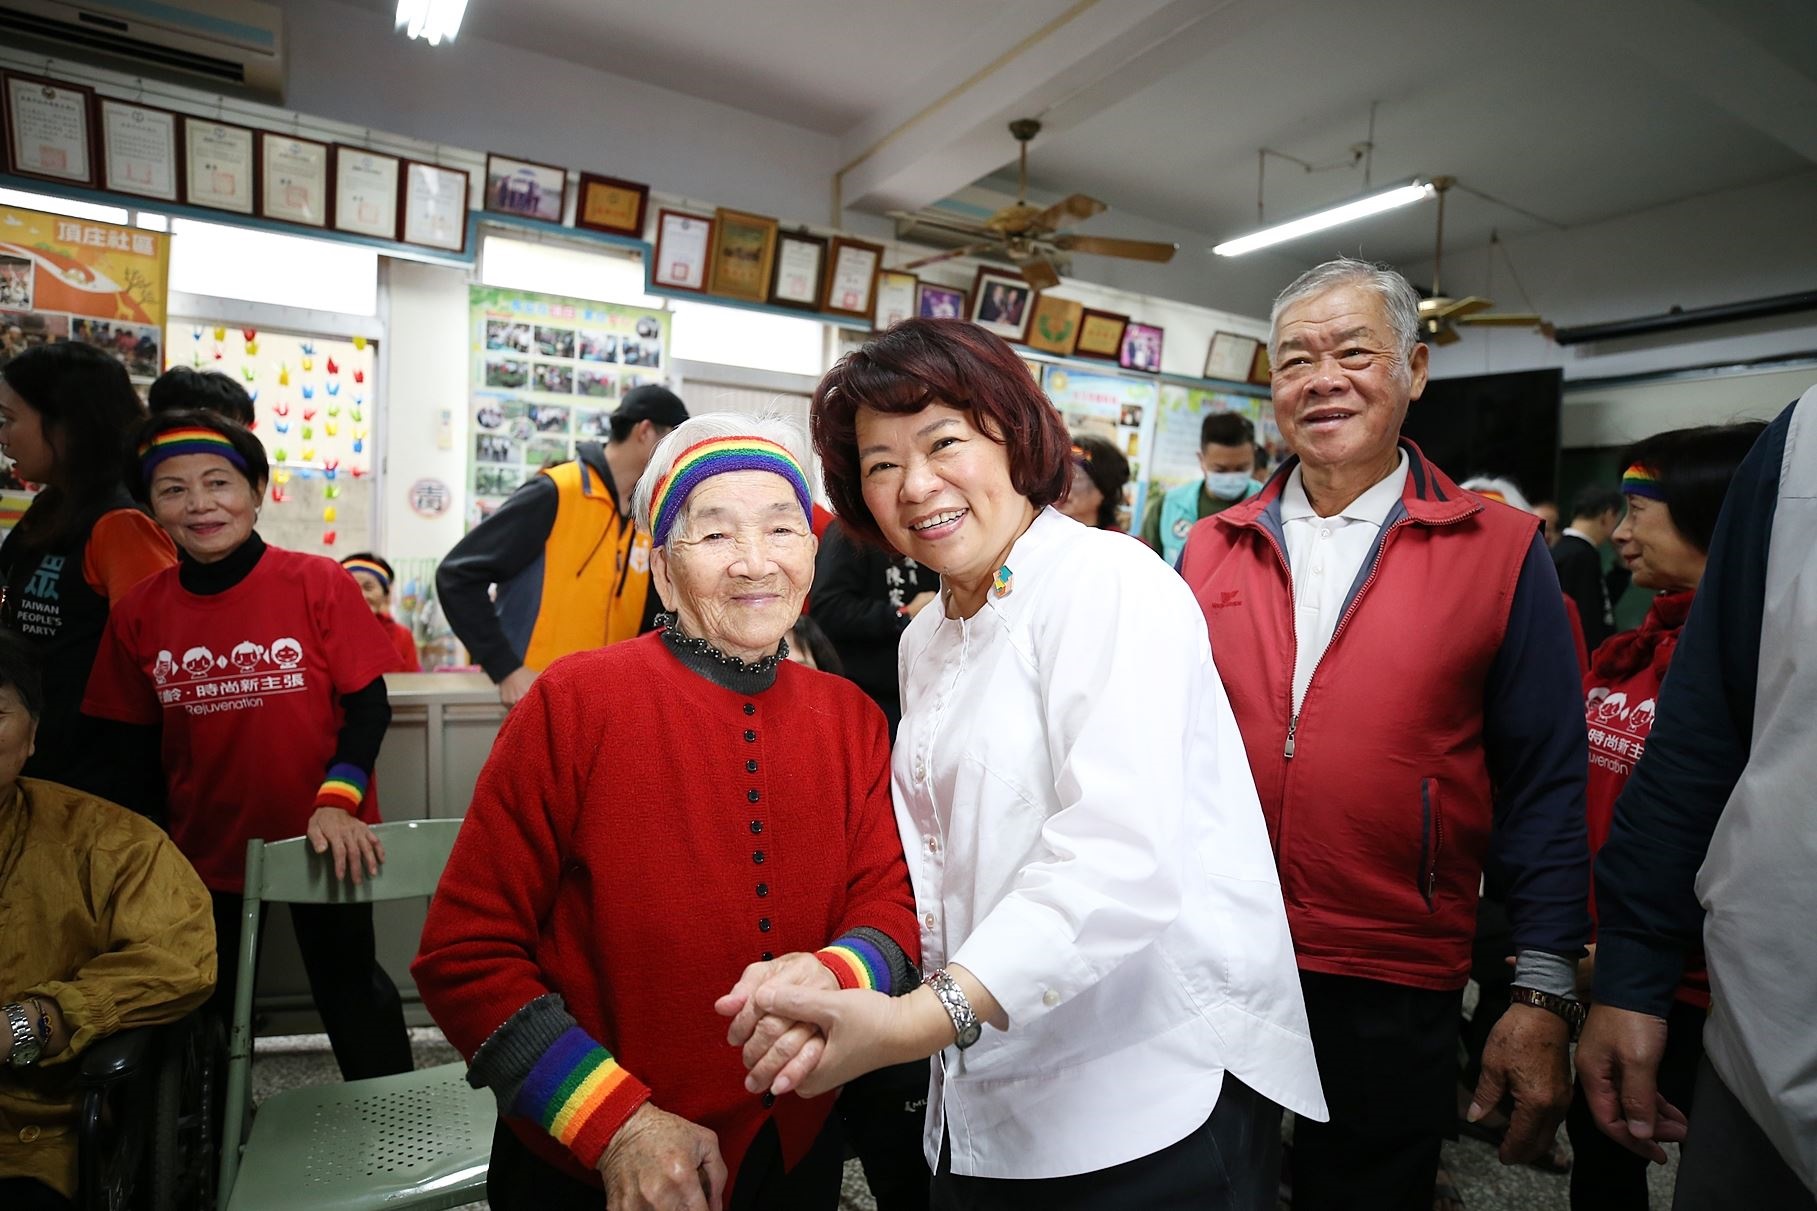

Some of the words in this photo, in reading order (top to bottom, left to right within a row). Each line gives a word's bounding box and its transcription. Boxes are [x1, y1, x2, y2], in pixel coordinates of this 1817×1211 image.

[58, 222, 155, 256] 頂庄社區
[22, 599, 60, 615] TAIWAN
[17, 610, 63, 626] PEOPLE'S
[22, 623, 57, 636] PARTY
[160, 673, 304, 703] 齡·時尚新主張
[185, 697, 264, 715] Rejuvenation
[1588, 728, 1645, 760] 時尚新主
